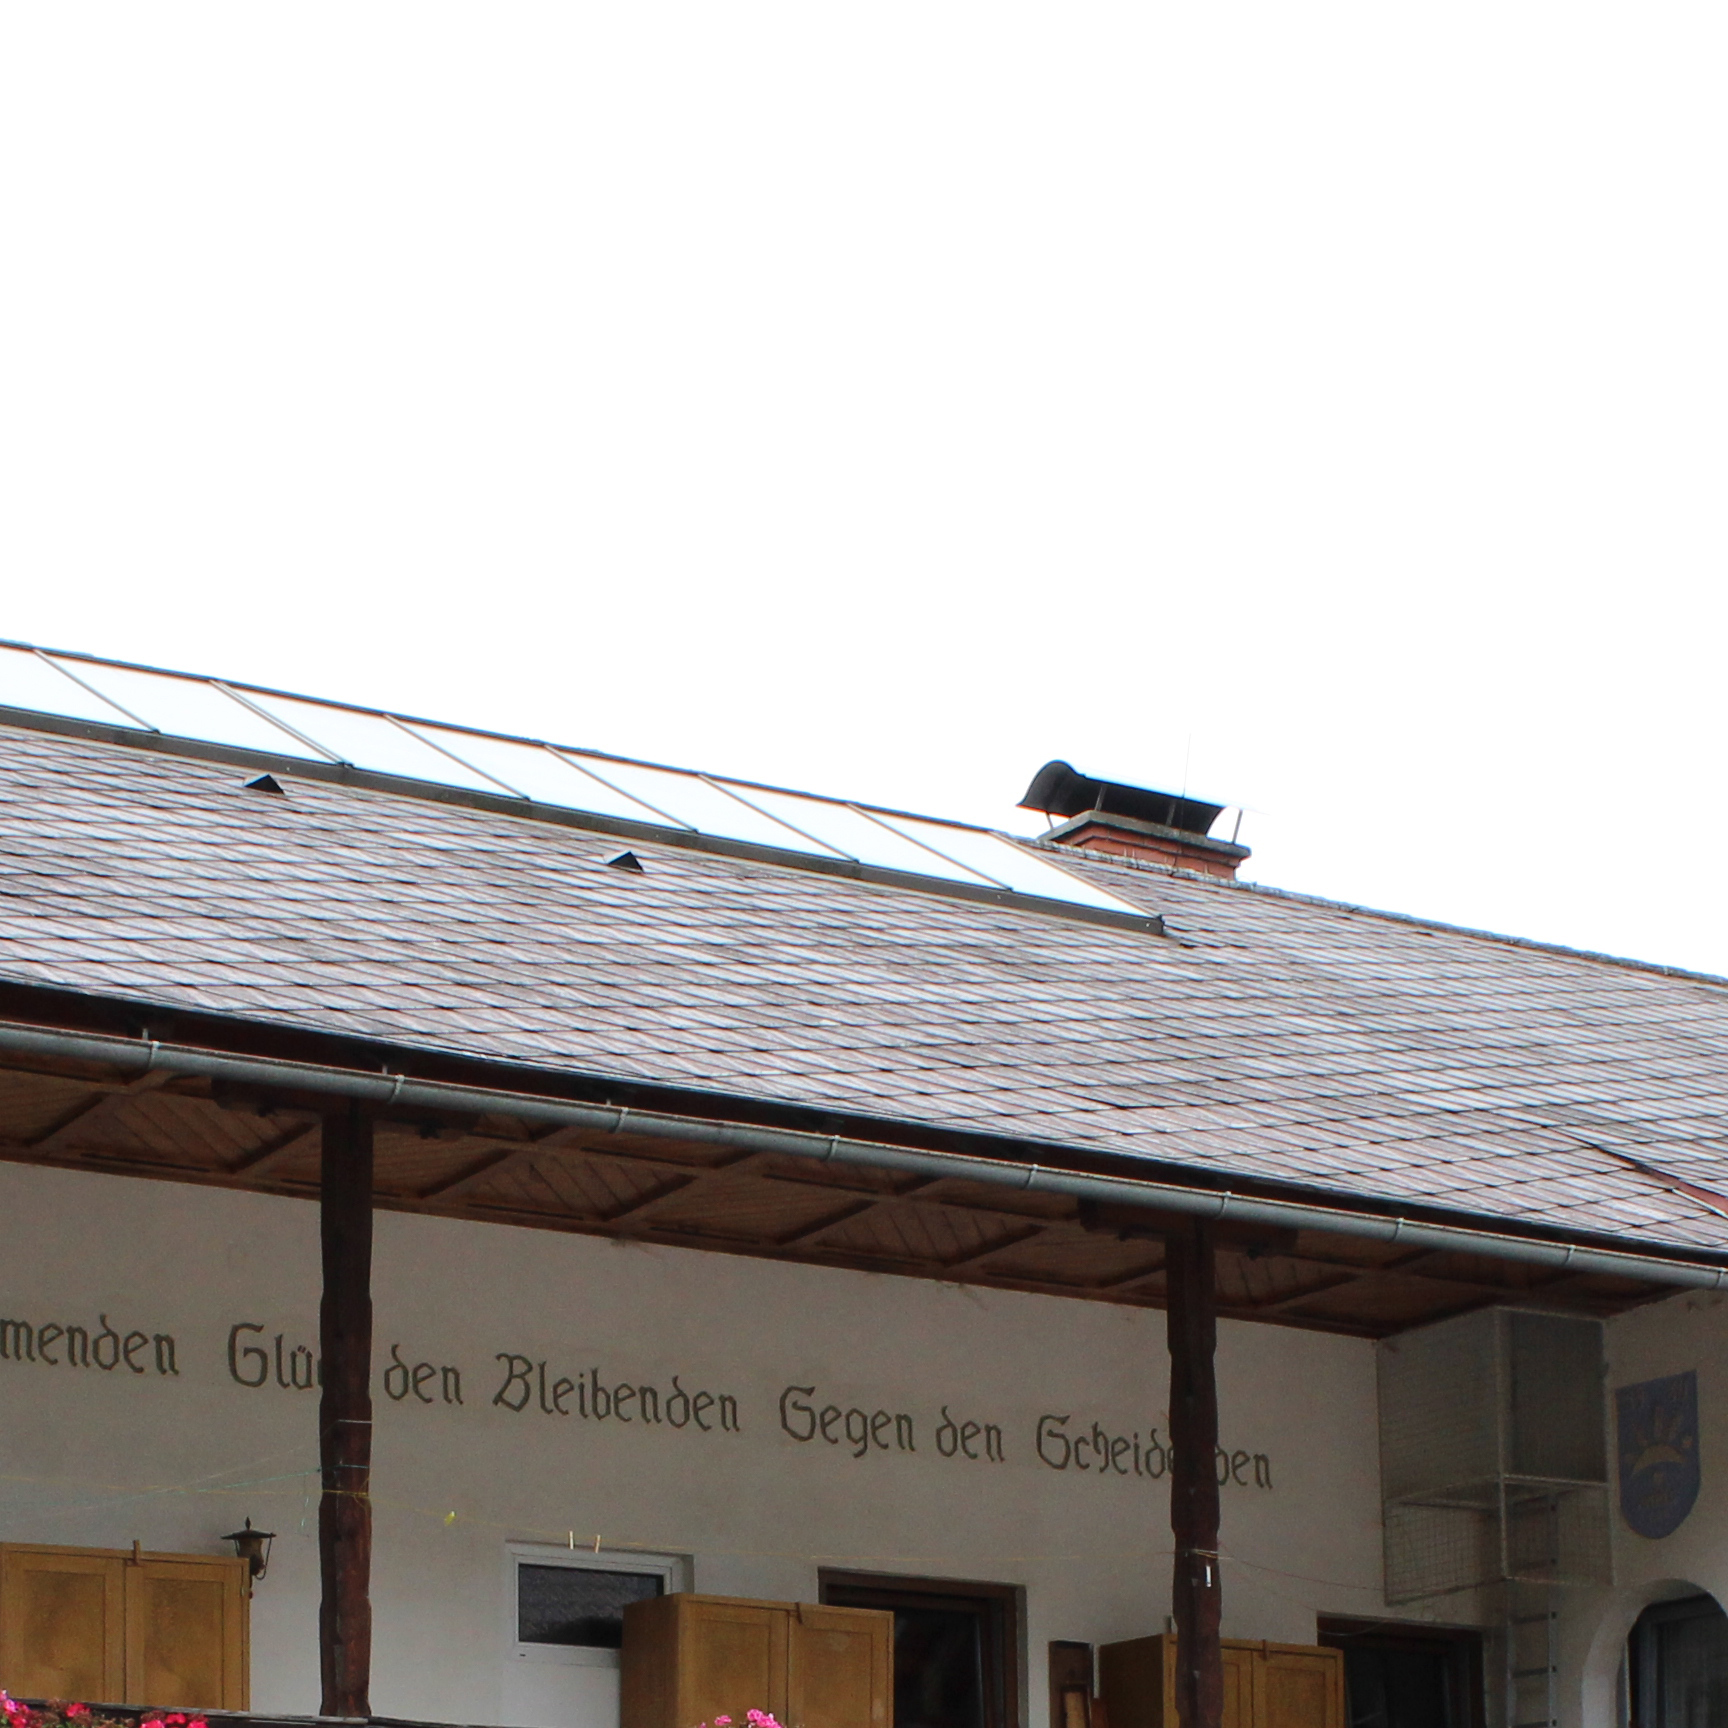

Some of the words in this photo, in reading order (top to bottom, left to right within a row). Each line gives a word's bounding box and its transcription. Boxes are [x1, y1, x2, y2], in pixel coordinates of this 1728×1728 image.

[227, 1322, 323, 1391] Glü
[383, 1343, 464, 1405] den
[493, 1353, 740, 1433] Bleibenden
[935, 1405, 1005, 1462] den
